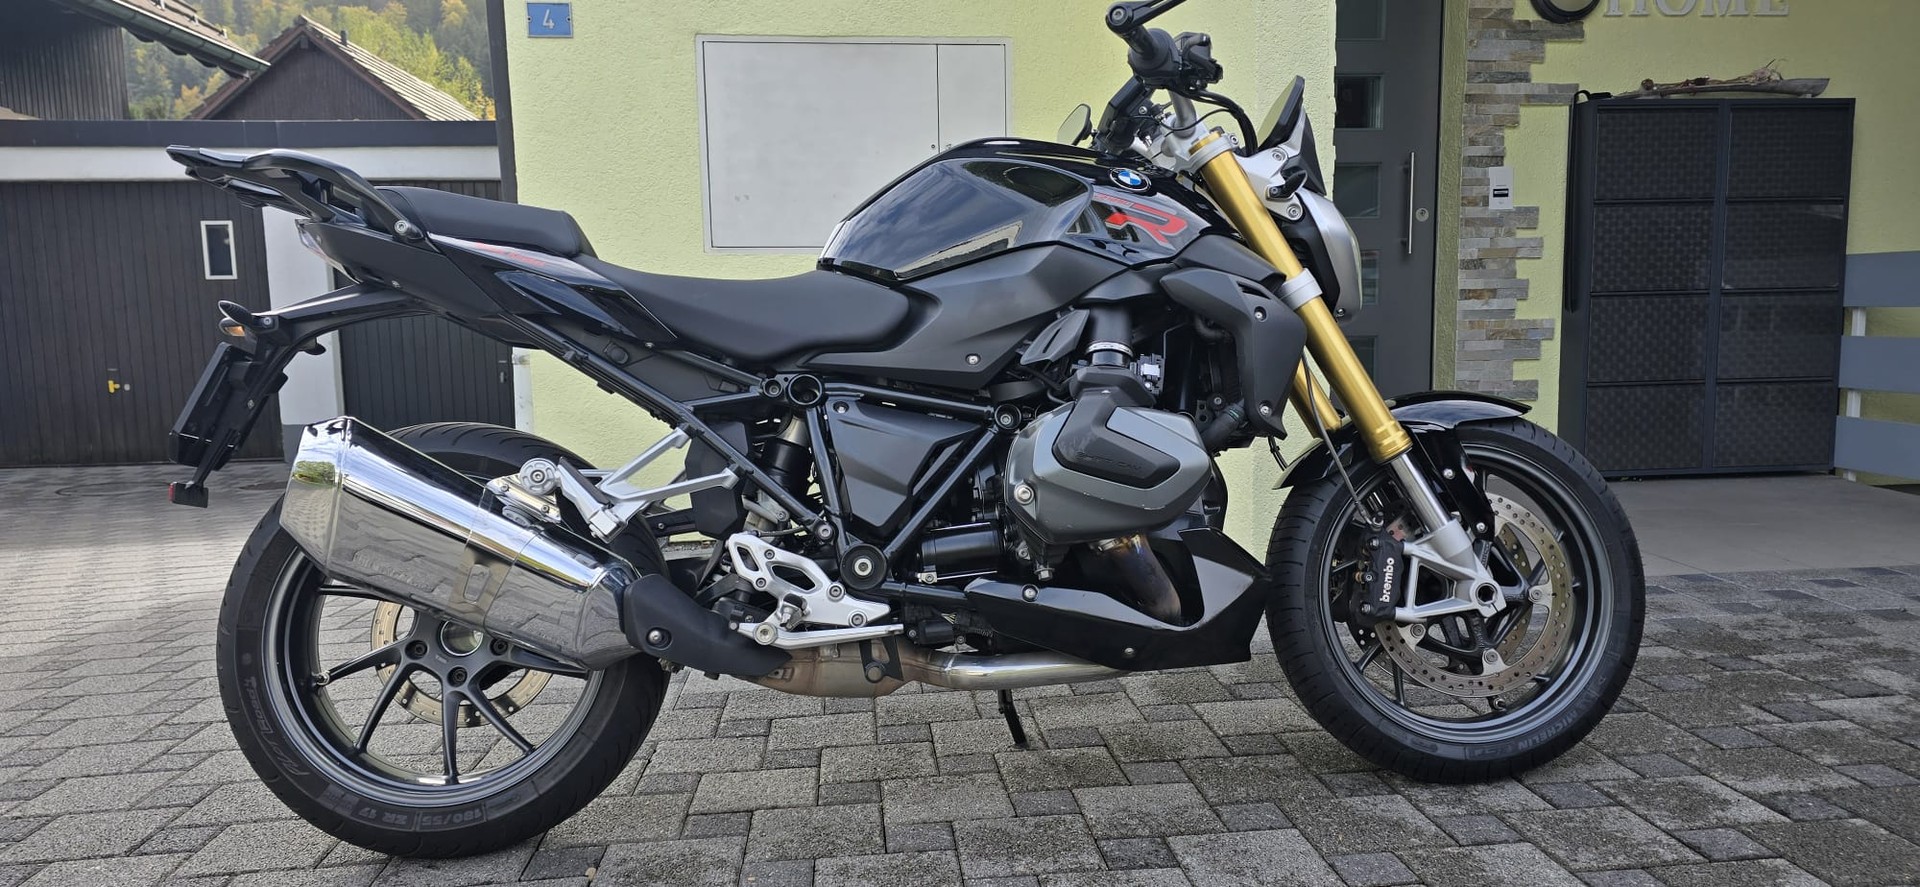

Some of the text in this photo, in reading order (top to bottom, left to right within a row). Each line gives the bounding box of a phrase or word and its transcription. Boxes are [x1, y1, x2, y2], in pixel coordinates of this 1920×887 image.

[543, 9, 555, 29] 4
[1379, 557, 1395, 603] brembo
[1519, 710, 1578, 750] MICHELIN
[358, 807, 377, 819] 17
[421, 808, 482, 826] 180/55
